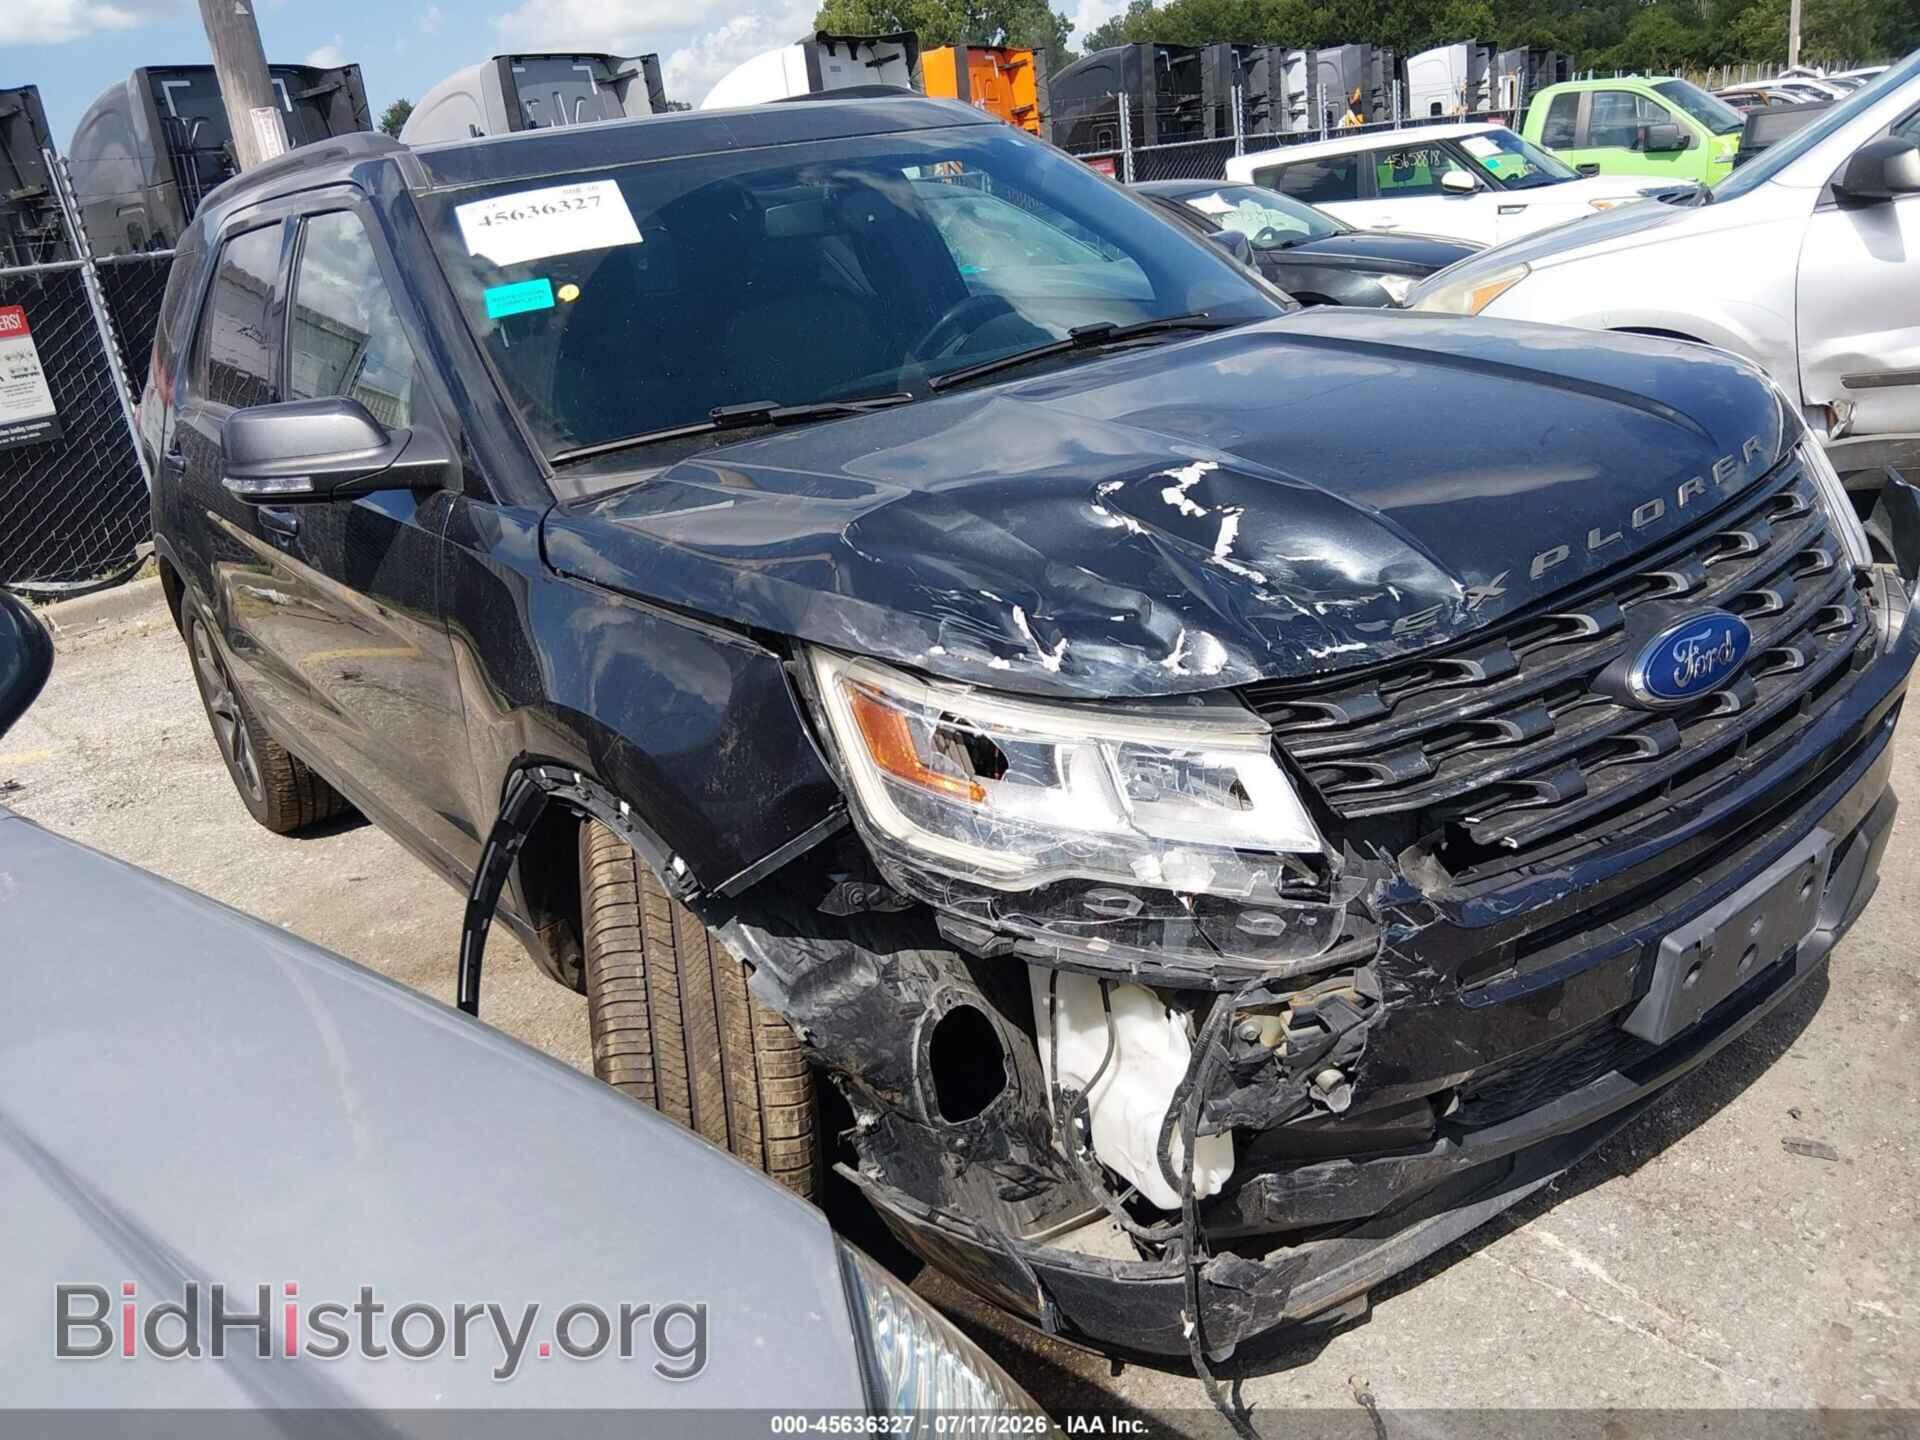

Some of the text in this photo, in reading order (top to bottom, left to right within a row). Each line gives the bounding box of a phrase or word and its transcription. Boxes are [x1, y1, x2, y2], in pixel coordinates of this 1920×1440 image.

[478, 195, 601, 227] 45636327
[1391, 434, 1763, 637] EXPLORER
[1672, 628, 1735, 688] Ford
